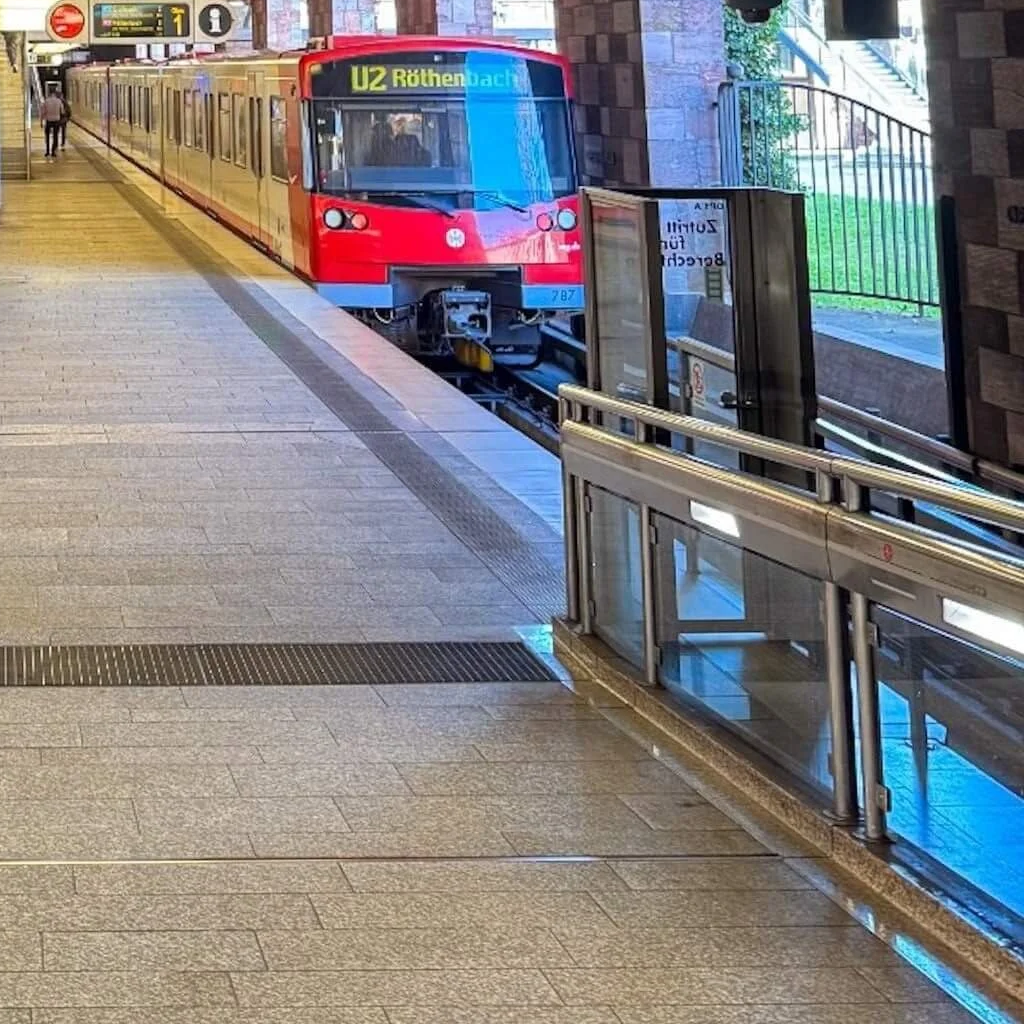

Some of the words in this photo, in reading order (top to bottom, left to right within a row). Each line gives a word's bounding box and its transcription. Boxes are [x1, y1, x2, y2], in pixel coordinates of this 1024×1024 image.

[172, 13, 183, 36] 1
[350, 64, 387, 92] U2
[392, 67, 518, 88] Röthenbach
[551, 289, 576, 302] 787
